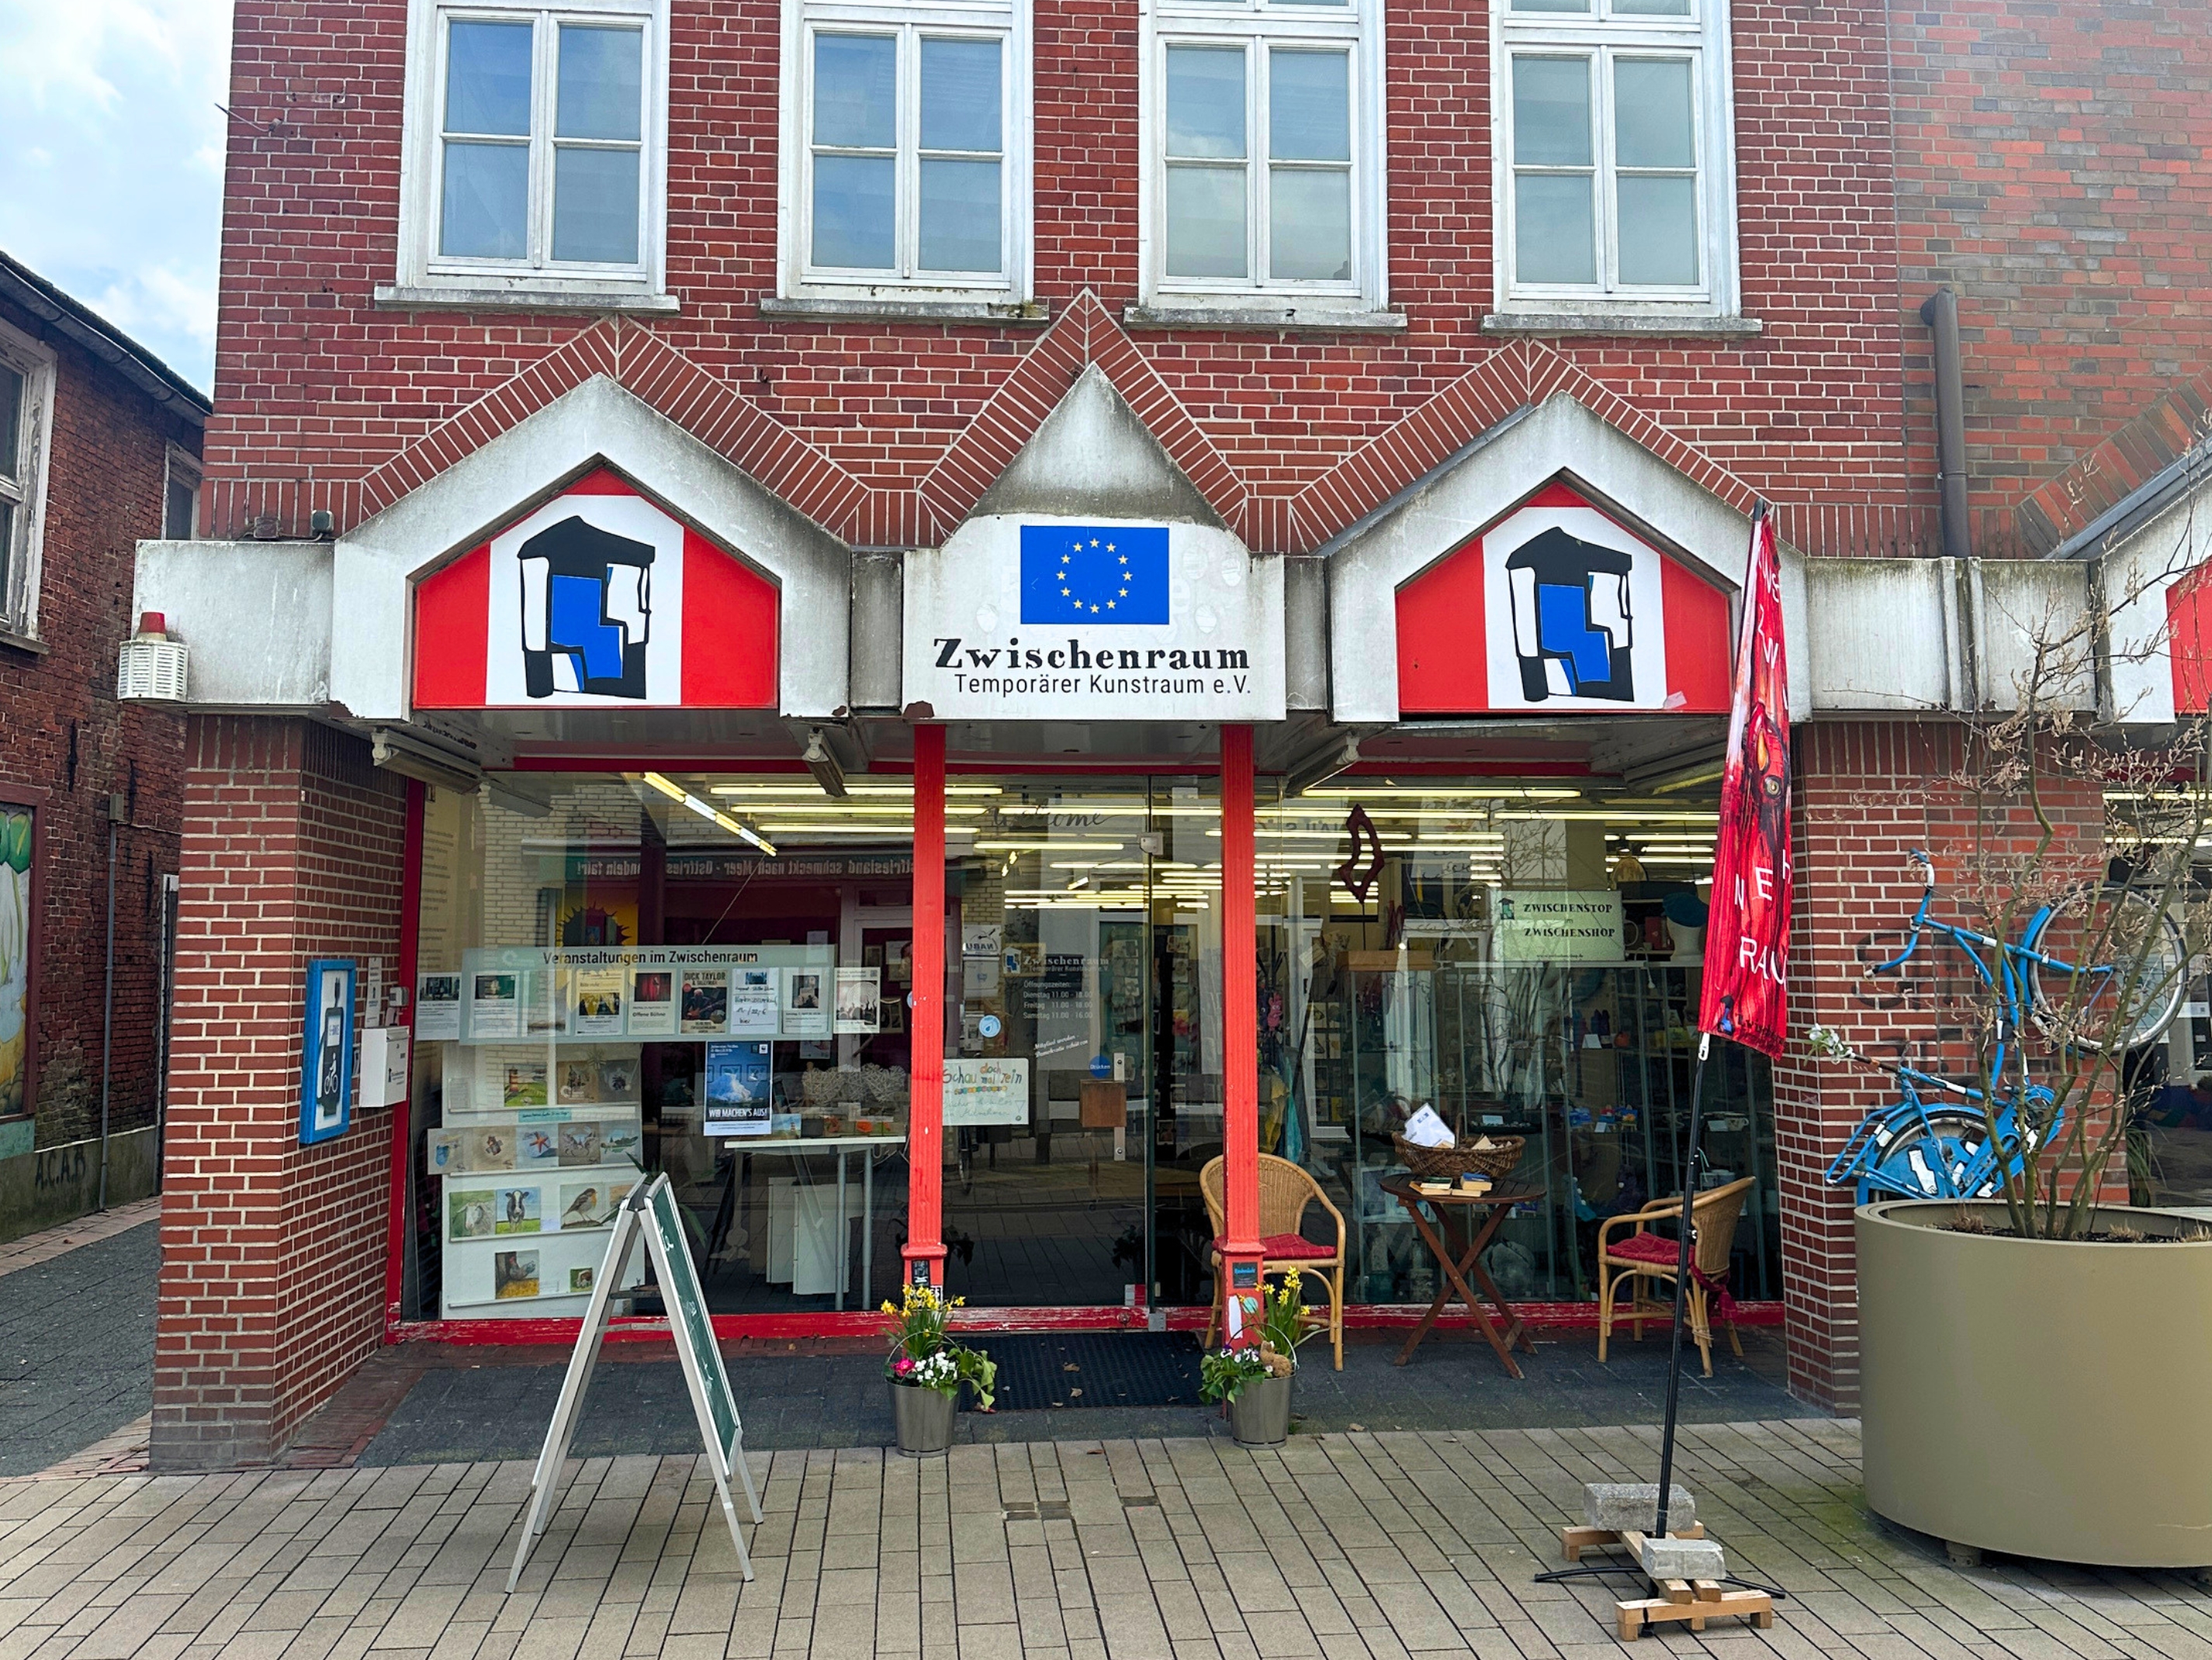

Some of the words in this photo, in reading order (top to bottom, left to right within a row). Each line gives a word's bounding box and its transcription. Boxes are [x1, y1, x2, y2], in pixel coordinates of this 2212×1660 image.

[933, 638, 1250, 670] Zwischenraum
[954, 673, 1081, 697] Temporärer
[1090, 674, 1204, 694] Kunstraum
[1213, 674, 1251, 694] e.V.
[1523, 904, 1613, 913] ZWISCHENSTOP
[1524, 928, 1615, 937] ZWISCHENSHOP
[543, 951, 646, 967] Veranstaltungen
[650, 950, 666, 963] im
[669, 950, 759, 963] Zwischenraum
[943, 1066, 977, 1084] Schau
[1000, 1069, 1023, 1084] rein
[980, 1061, 1002, 1074] doch
